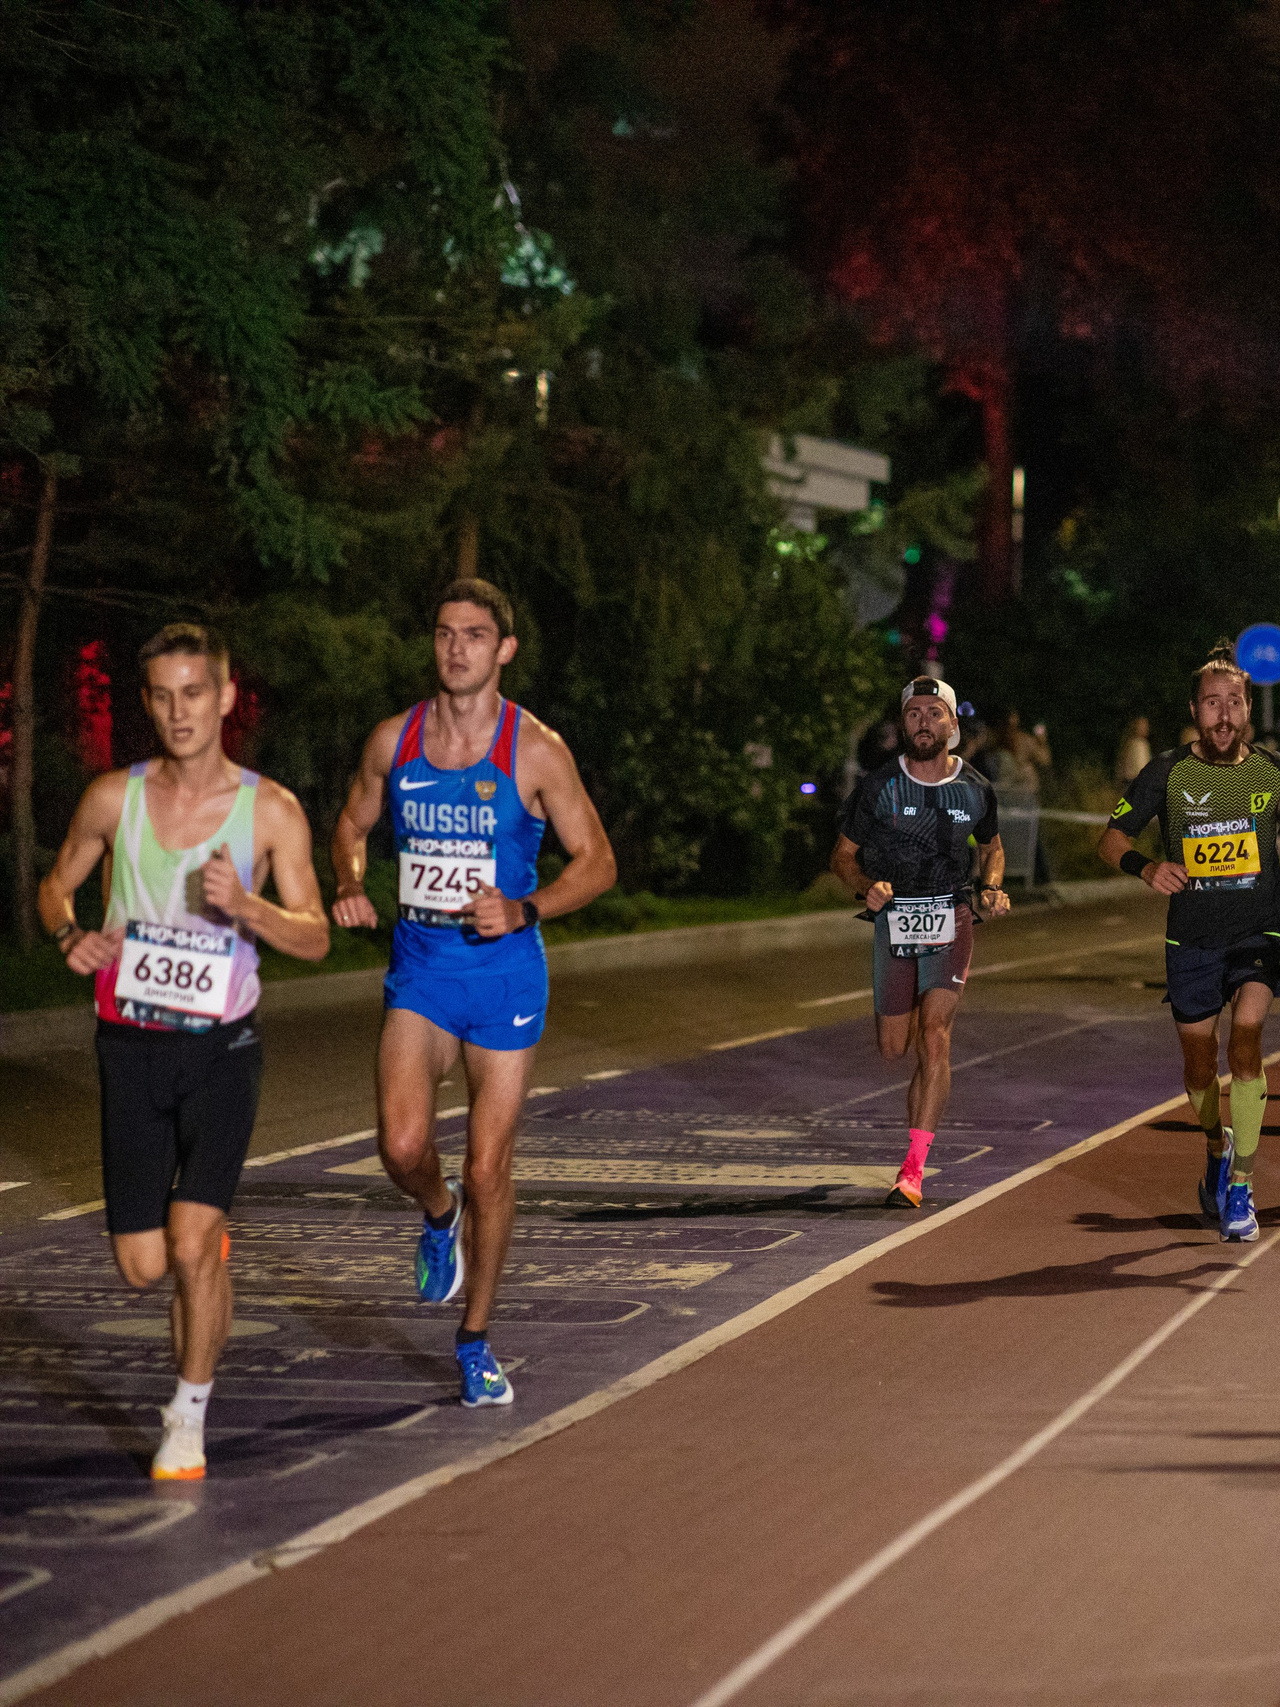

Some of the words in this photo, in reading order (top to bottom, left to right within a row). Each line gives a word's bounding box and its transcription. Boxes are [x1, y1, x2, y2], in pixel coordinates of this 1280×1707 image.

[402, 800, 498, 835] RUSSIA
[1194, 840, 1249, 864] 6224
[410, 862, 482, 894] 7245
[1210, 864, 1236, 872] ЛИДИЯ
[897, 914, 946, 933] 3207
[134, 953, 213, 993] 6386
